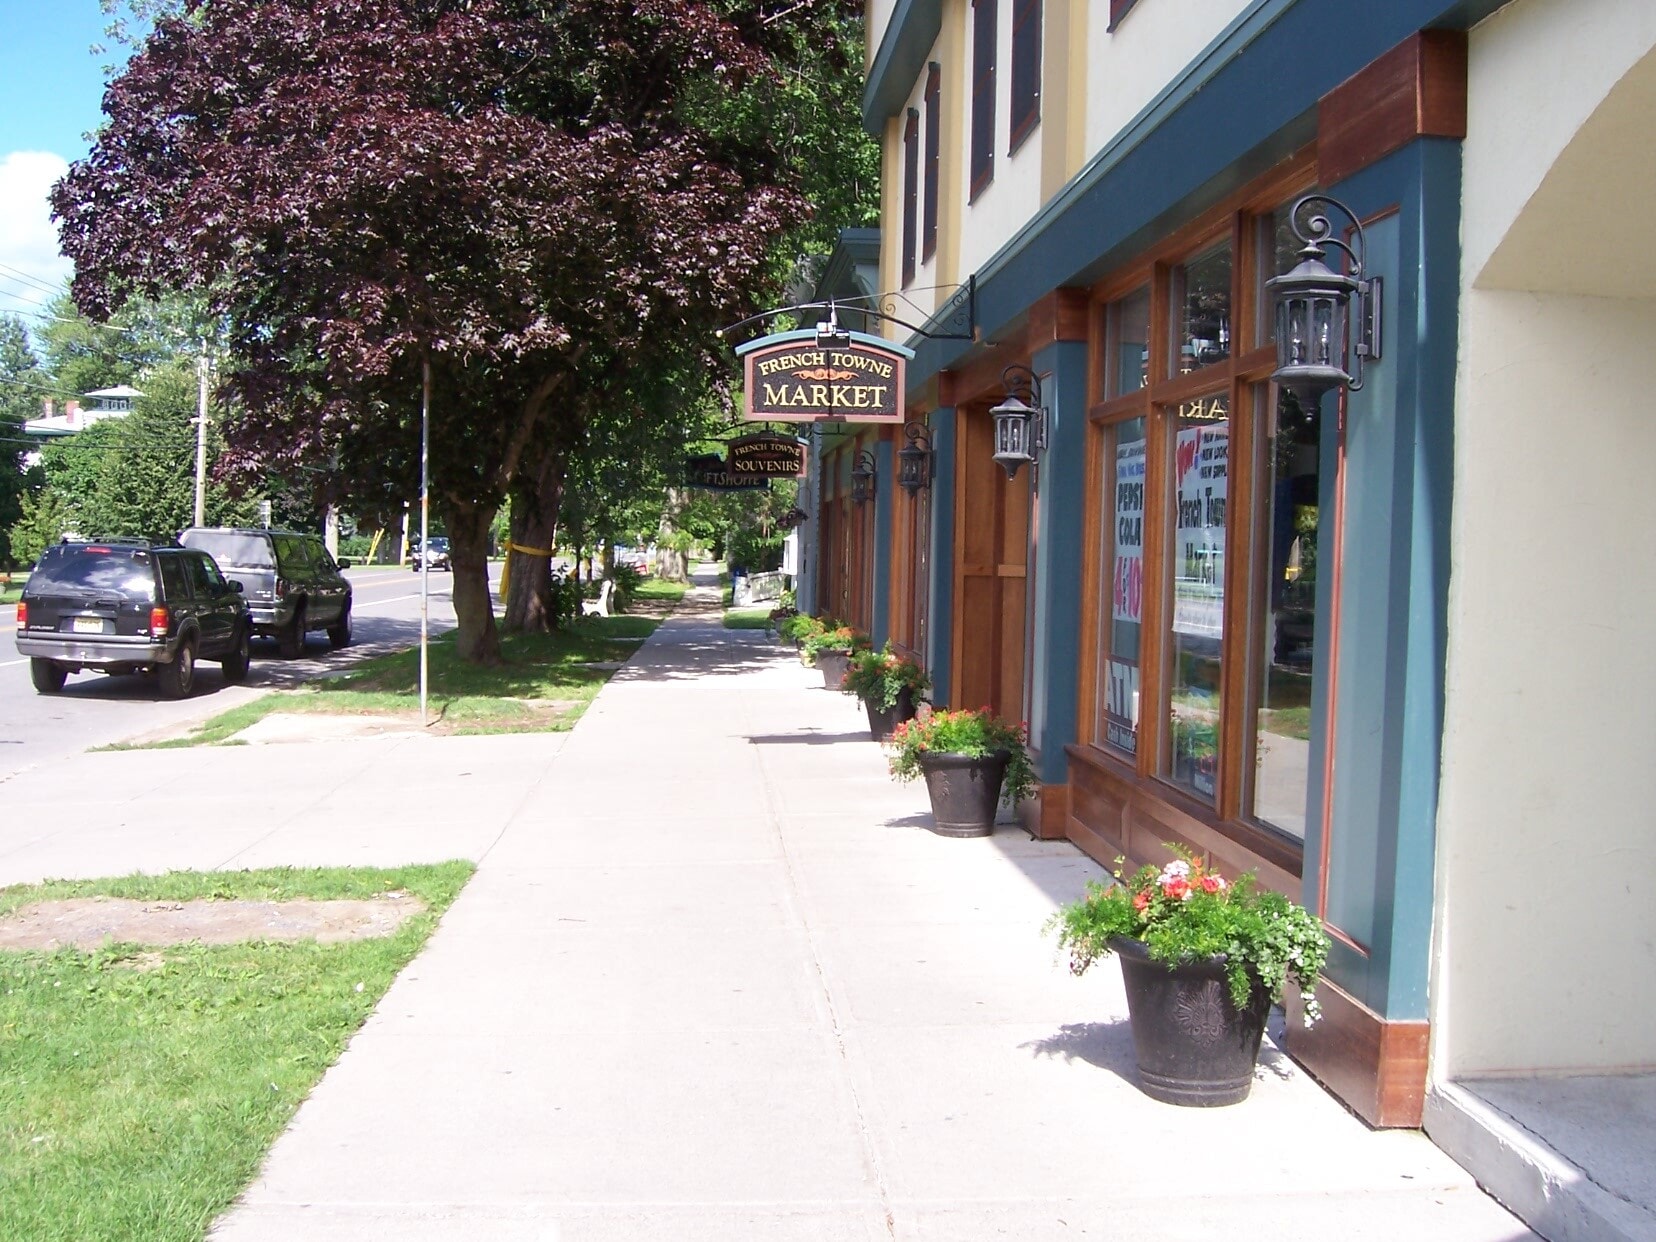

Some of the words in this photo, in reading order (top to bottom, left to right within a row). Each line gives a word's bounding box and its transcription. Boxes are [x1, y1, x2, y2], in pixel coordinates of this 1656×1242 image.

[758, 352, 825, 376] FRENCH
[831, 353, 893, 379] TOWNE
[763, 383, 887, 408] MARKET
[734, 443, 767, 456] FRENCH
[769, 443, 801, 457] TOWNE
[735, 459, 800, 472] SOUVENIRS
[1118, 482, 1143, 512] PEPSI
[1119, 516, 1141, 546] COLA
